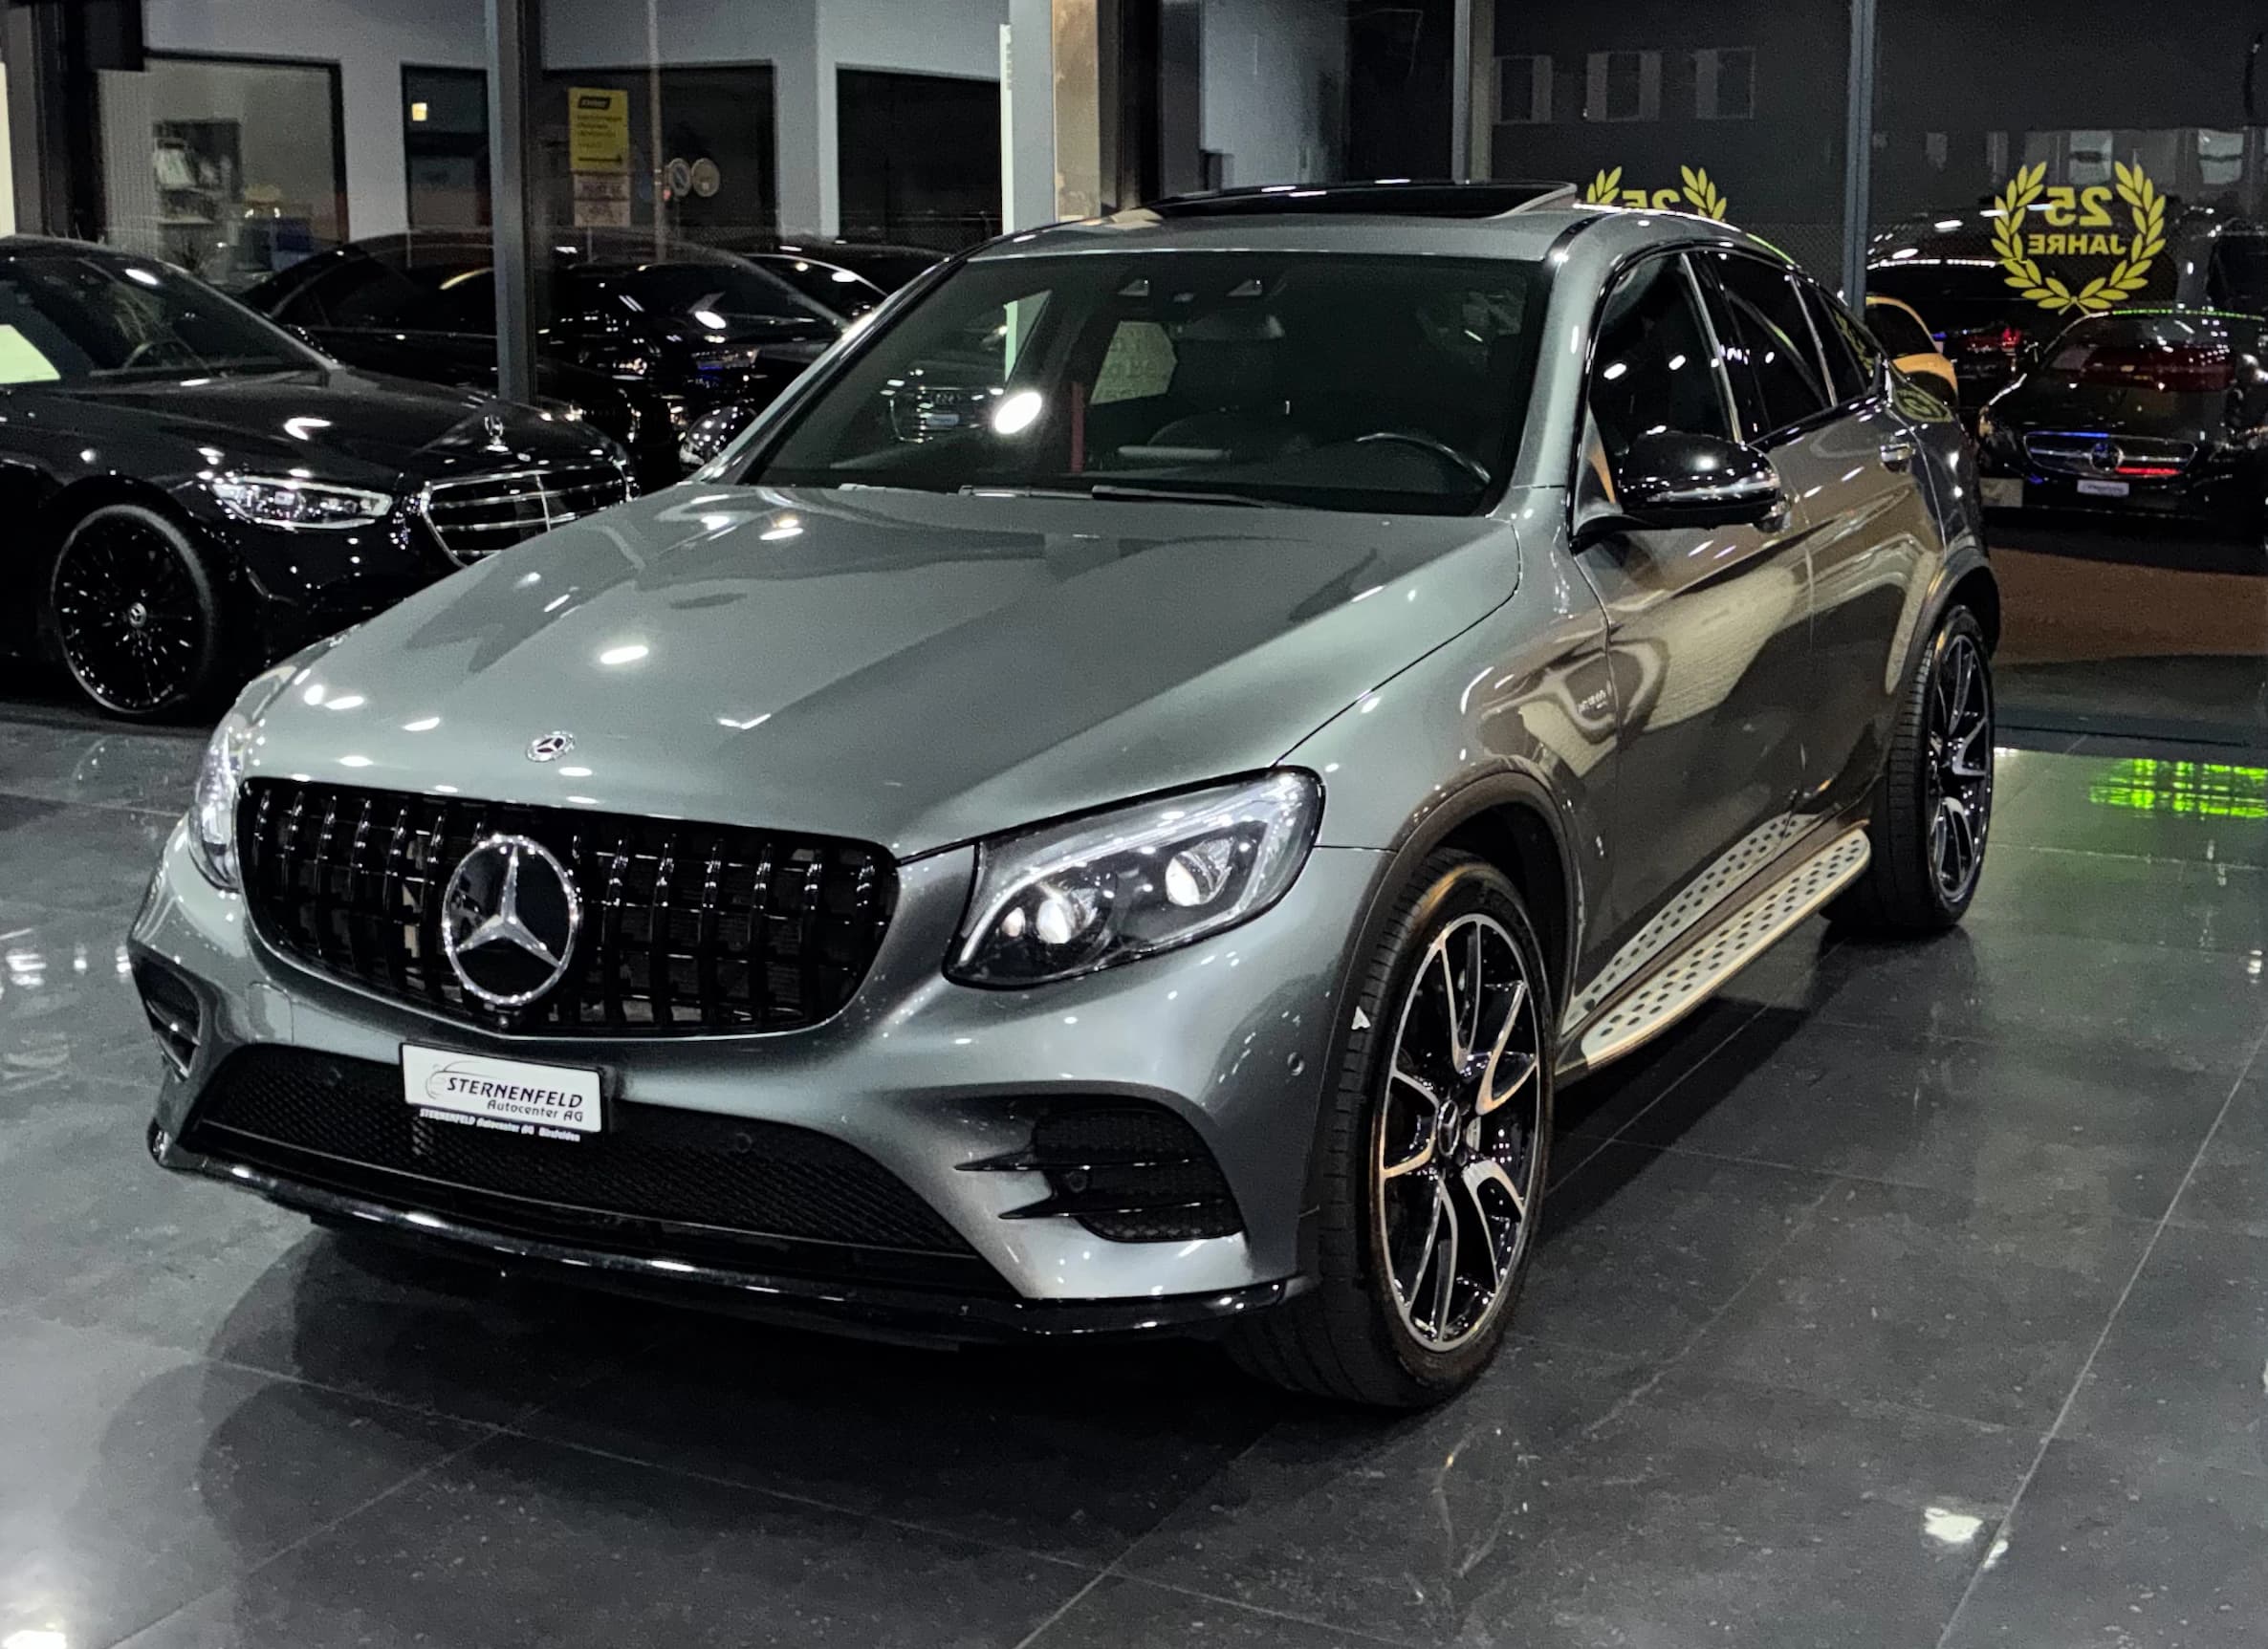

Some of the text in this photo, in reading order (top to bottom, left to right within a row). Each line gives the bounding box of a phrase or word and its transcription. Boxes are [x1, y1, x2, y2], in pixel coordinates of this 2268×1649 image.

[447, 1076, 583, 1109] STERNENFELD
[487, 1098, 584, 1122] Autocenter AG
